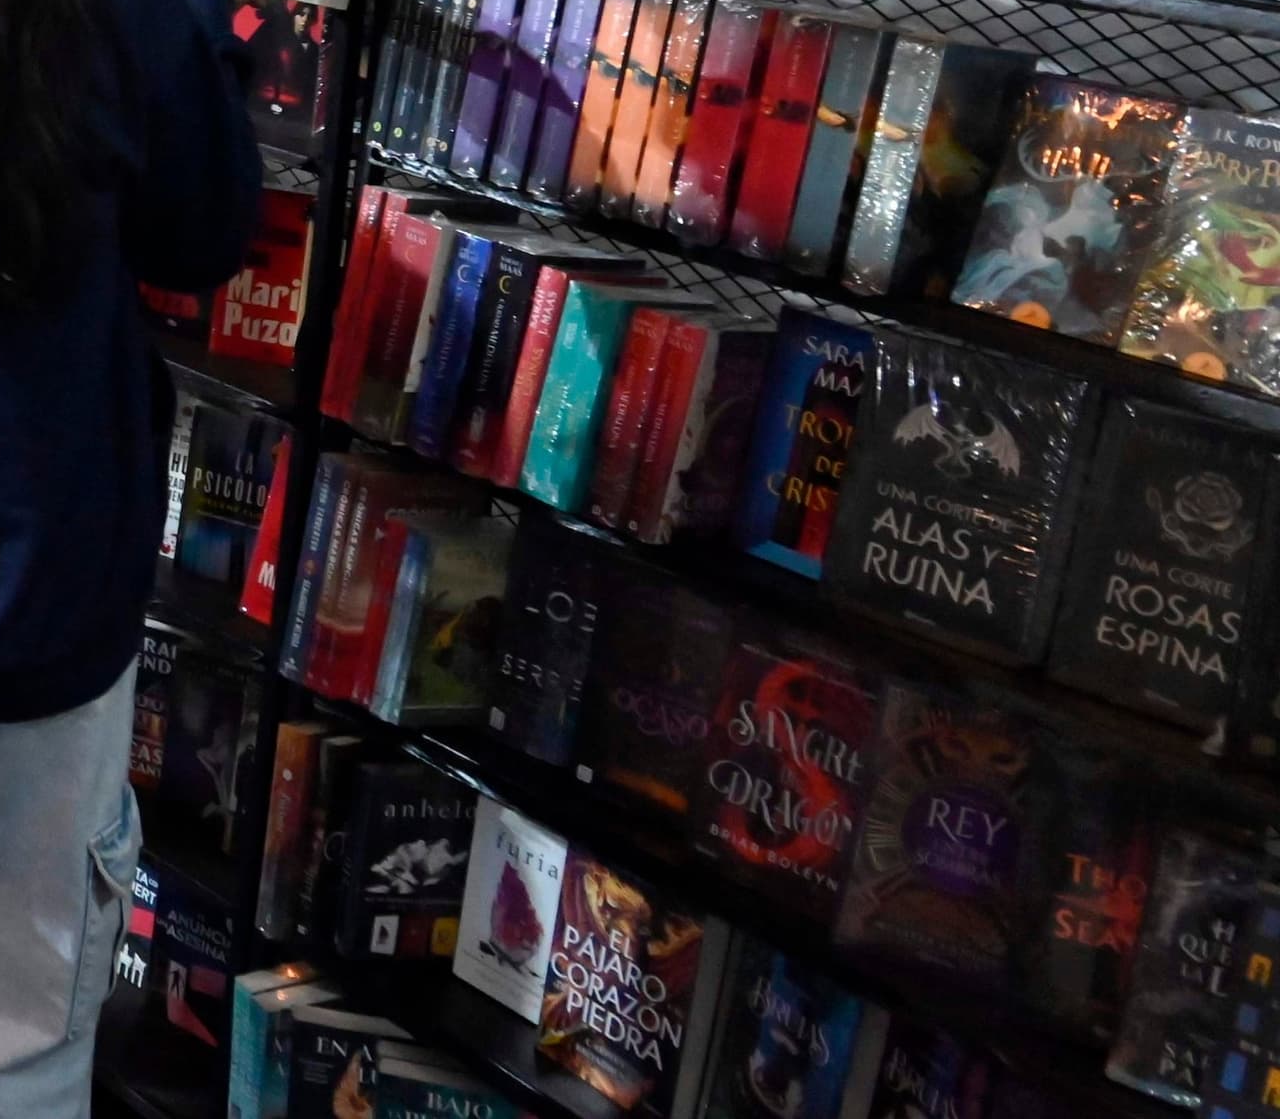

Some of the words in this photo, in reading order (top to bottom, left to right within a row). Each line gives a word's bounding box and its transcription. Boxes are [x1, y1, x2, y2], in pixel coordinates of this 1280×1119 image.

[227, 268, 302, 314] Mari
[803, 335, 865, 373] SARA
[192, 466, 267, 509] PSICOLO
[235, 451, 254, 476] LA
[815, 455, 848, 480] DE
[876, 480, 918, 506] UNA
[871, 506, 973, 561] ALAS
[982, 544, 1002, 569] Y
[862, 540, 997, 615] RUINA
[1114, 548, 1161, 577] UNA
[1167, 567, 1234, 600] CORTE
[1104, 574, 1241, 645] ROSAS
[1096, 615, 1228, 683] ESPINA
[927, 796, 1008, 848] REY
[493, 830, 559, 881] furia
[708, 823, 760, 857] BRIAR
[767, 848, 839, 893] BOLEYN
[563, 923, 668, 1004] PÁJARO
[608, 927, 634, 960] EL
[550, 950, 684, 1051] CORAZÓN
[565, 990, 665, 1074] PIEDRA
